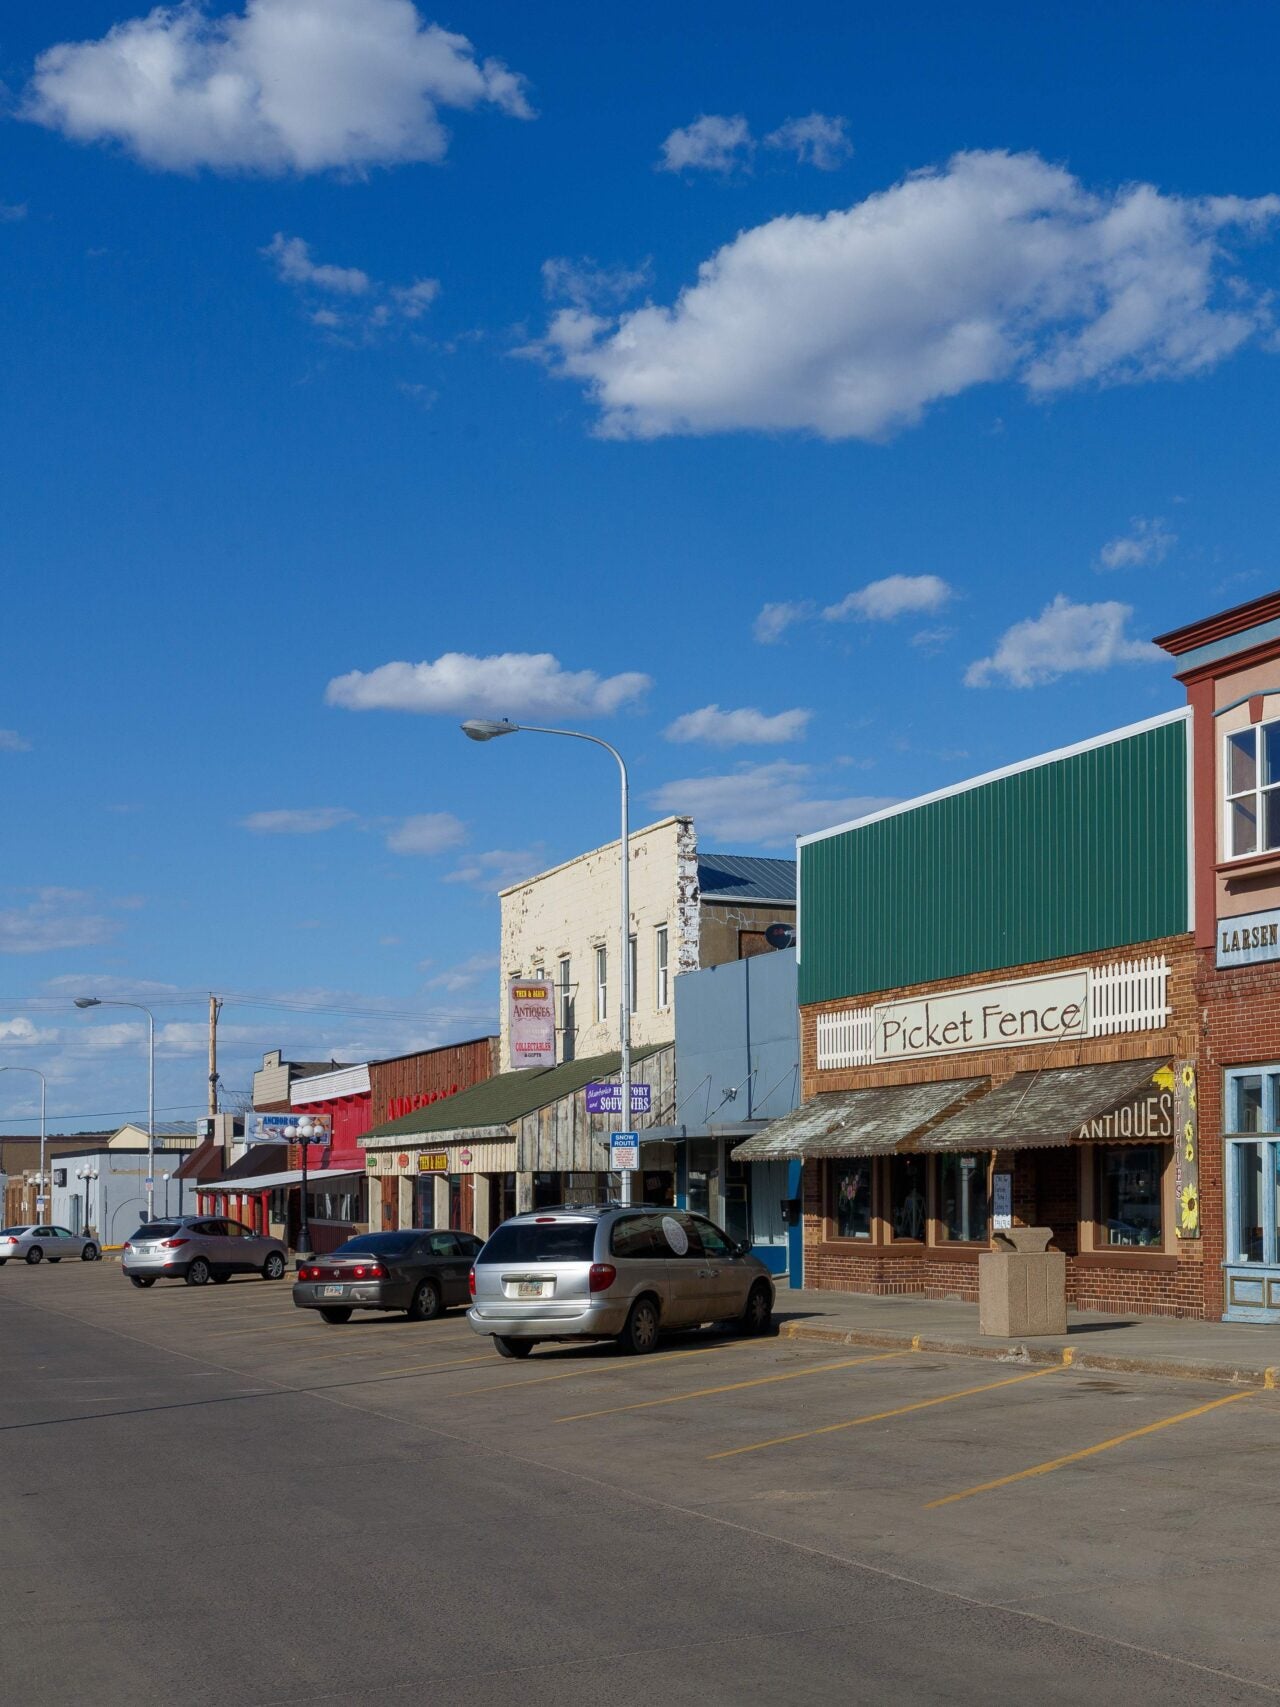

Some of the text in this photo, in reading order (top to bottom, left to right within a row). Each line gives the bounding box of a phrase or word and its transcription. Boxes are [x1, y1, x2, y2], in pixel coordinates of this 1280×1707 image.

[1222, 923, 1278, 953] LARSEN
[513, 1004, 551, 1020] ANTIQUES
[882, 1002, 1081, 1053] Picket Fence
[613, 1086, 649, 1096] HIORY
[264, 1116, 288, 1125] ANCHOR
[1079, 1093, 1172, 1138] ANTIQUES
